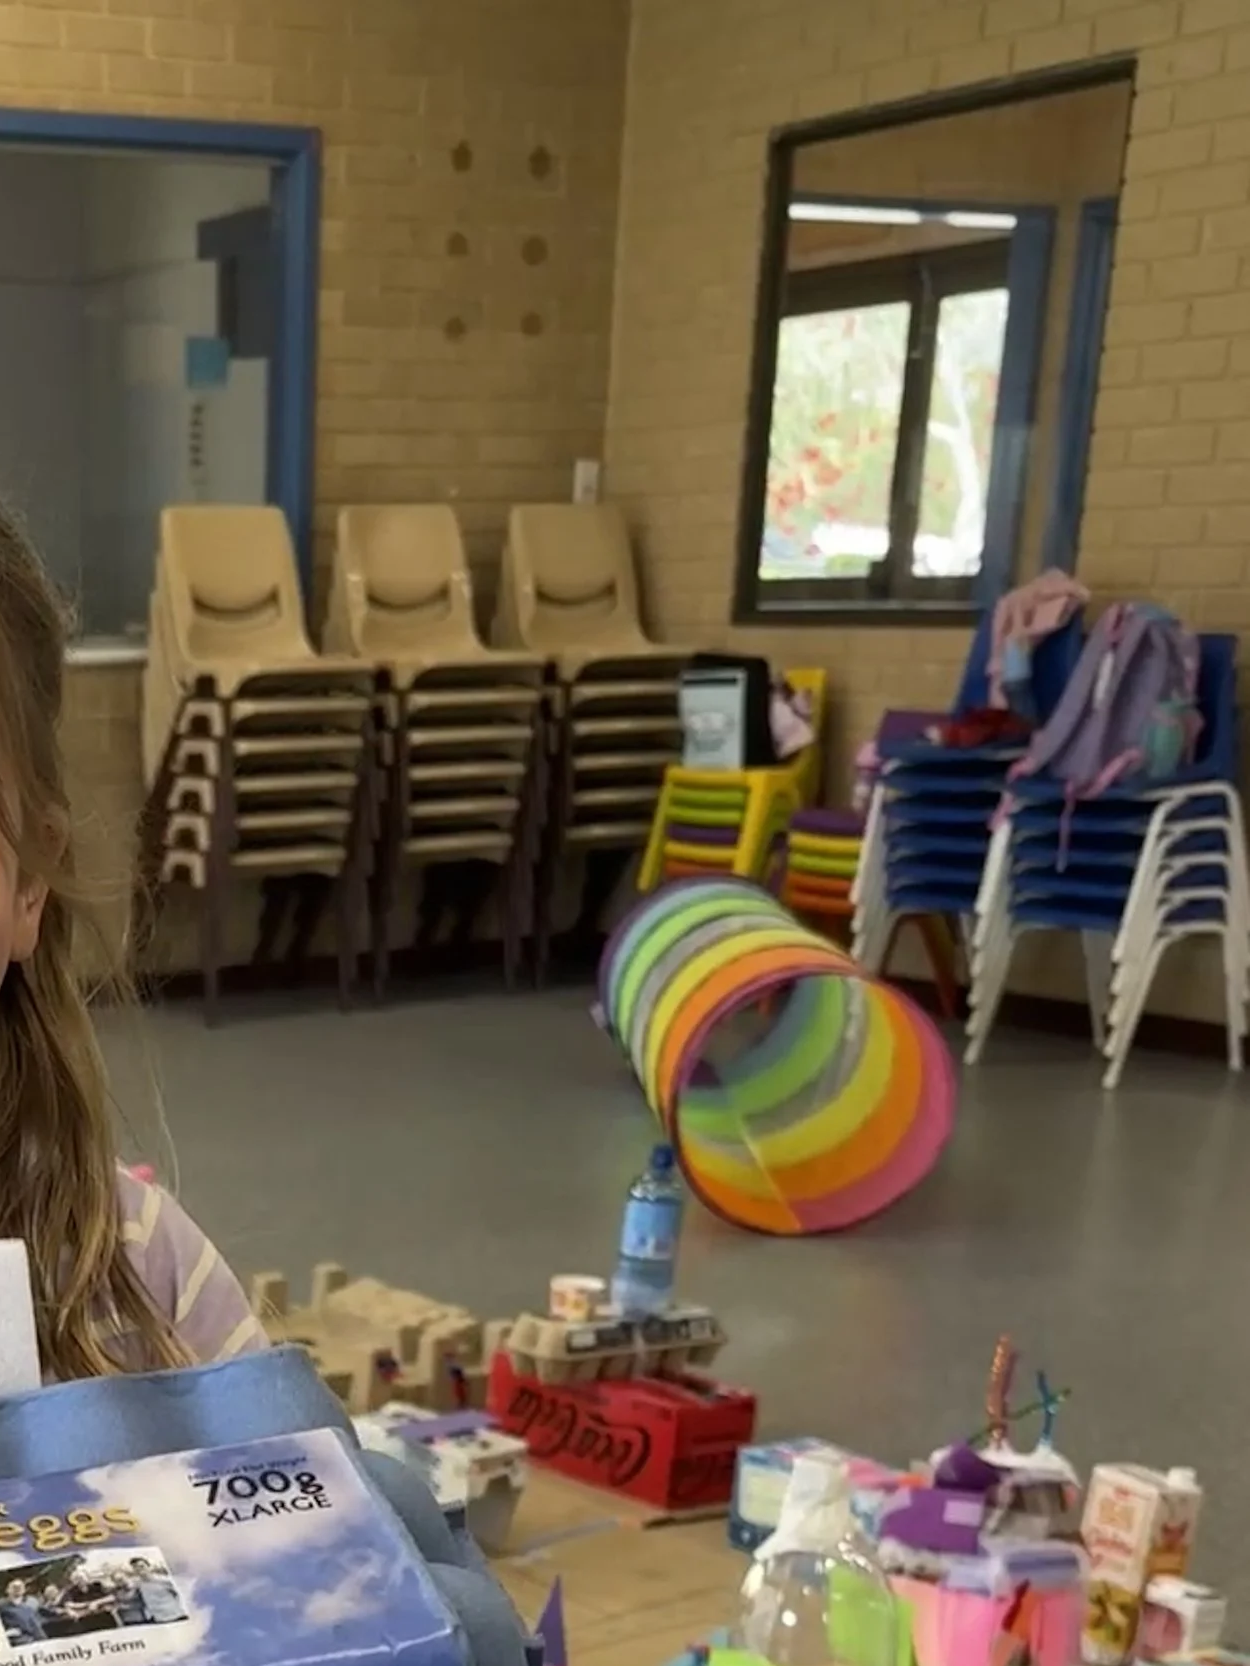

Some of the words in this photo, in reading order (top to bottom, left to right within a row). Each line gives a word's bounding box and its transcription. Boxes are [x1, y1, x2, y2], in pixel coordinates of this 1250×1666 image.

[192, 1469, 324, 1506] 700g
[207, 1493, 333, 1528] XLARGE
[32, 1644, 94, 1666] Family
[99, 1638, 147, 1655] Farm
